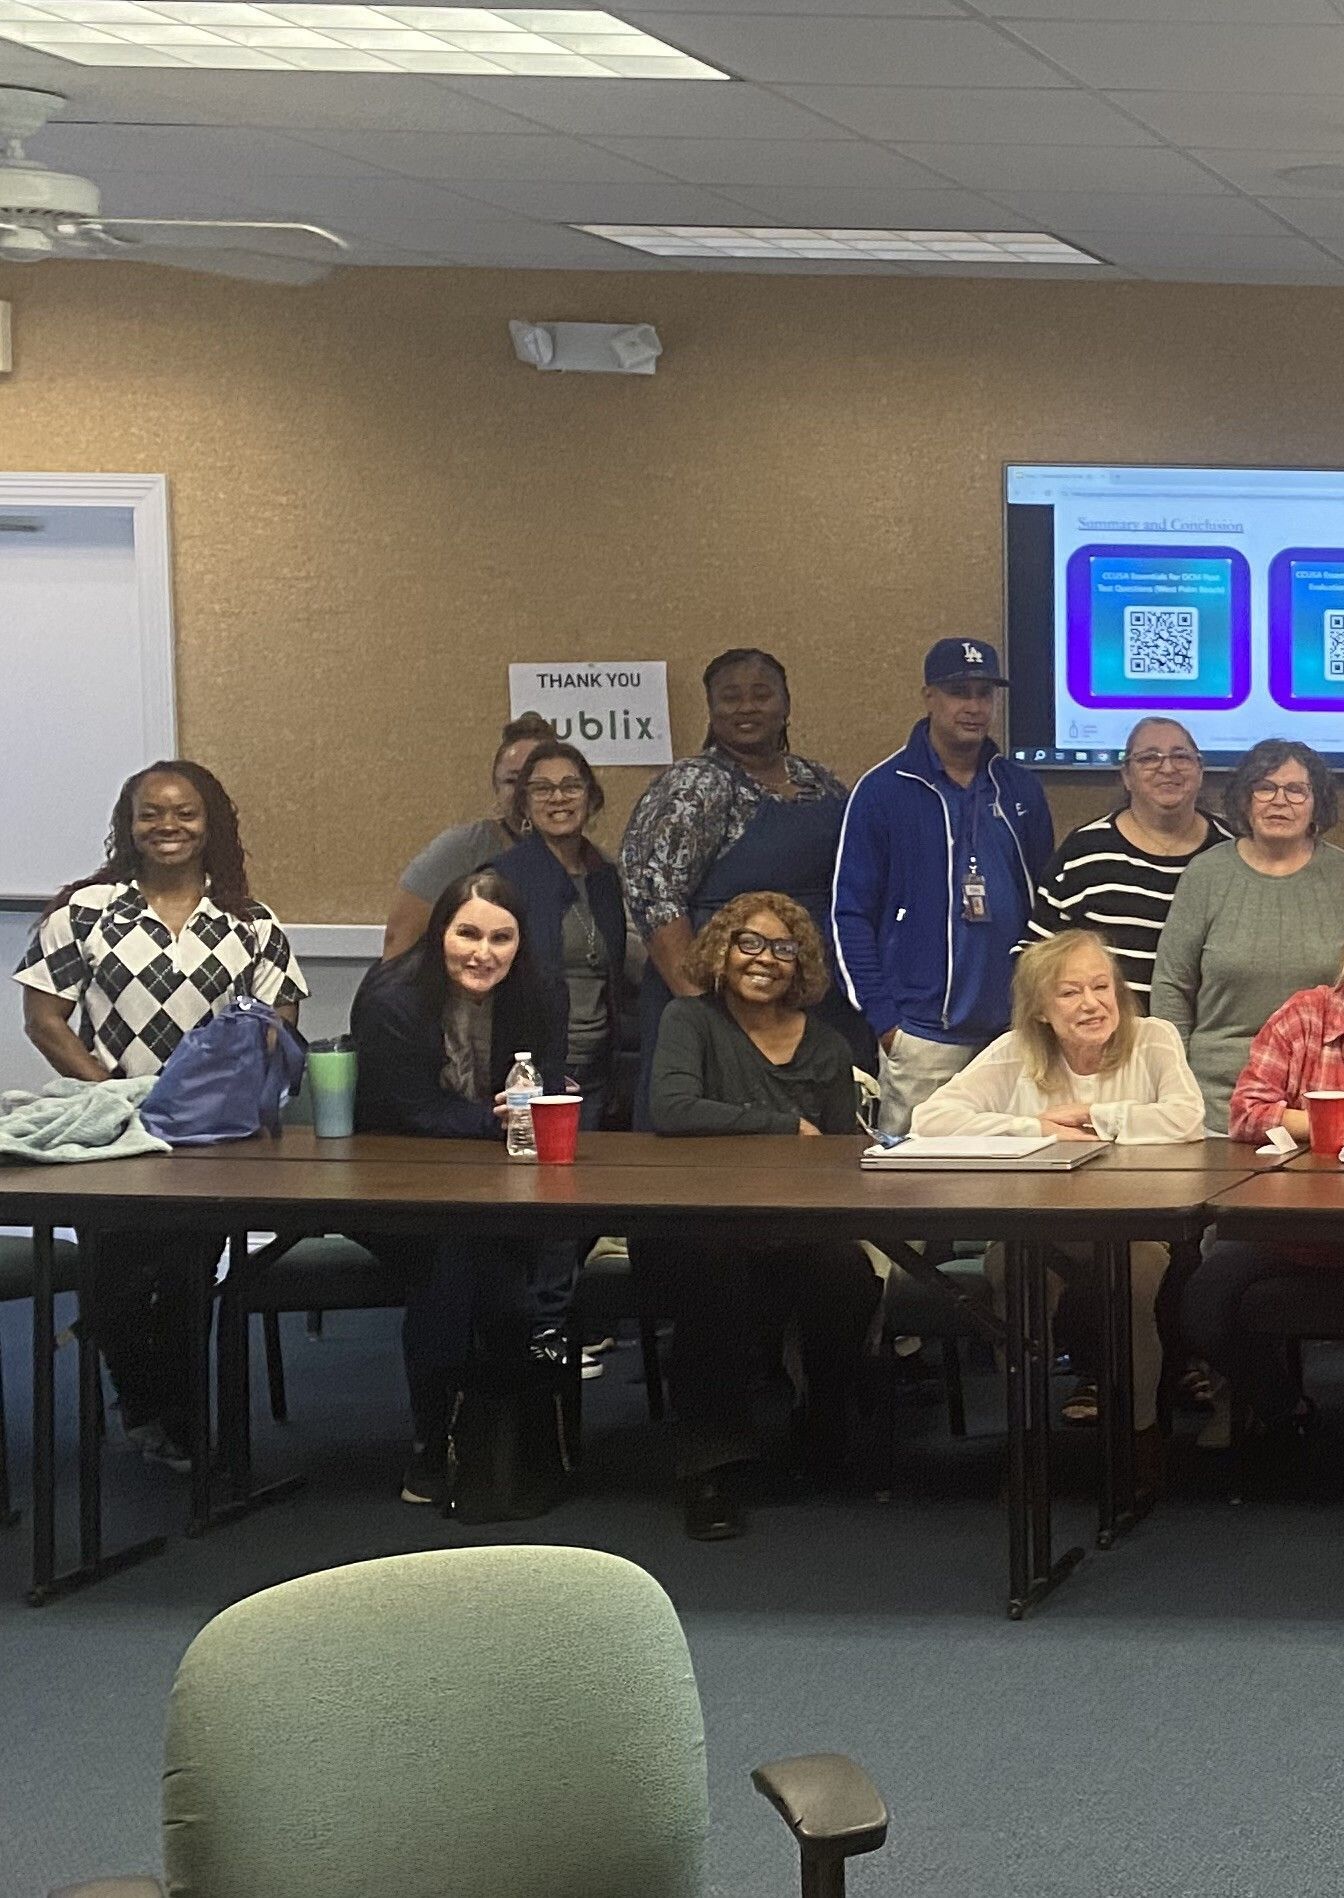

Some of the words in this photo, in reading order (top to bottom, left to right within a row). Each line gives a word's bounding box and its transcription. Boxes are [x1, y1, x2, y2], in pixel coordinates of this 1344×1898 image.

[1077, 516, 1138, 532] Summary
[1143, 518, 1167, 531] and
[1170, 518, 1244, 533] Conclusion
[961, 642, 983, 663] LA
[537, 672, 603, 689] THANK
[606, 672, 641, 688] YOU
[519, 709, 655, 741] ublix
